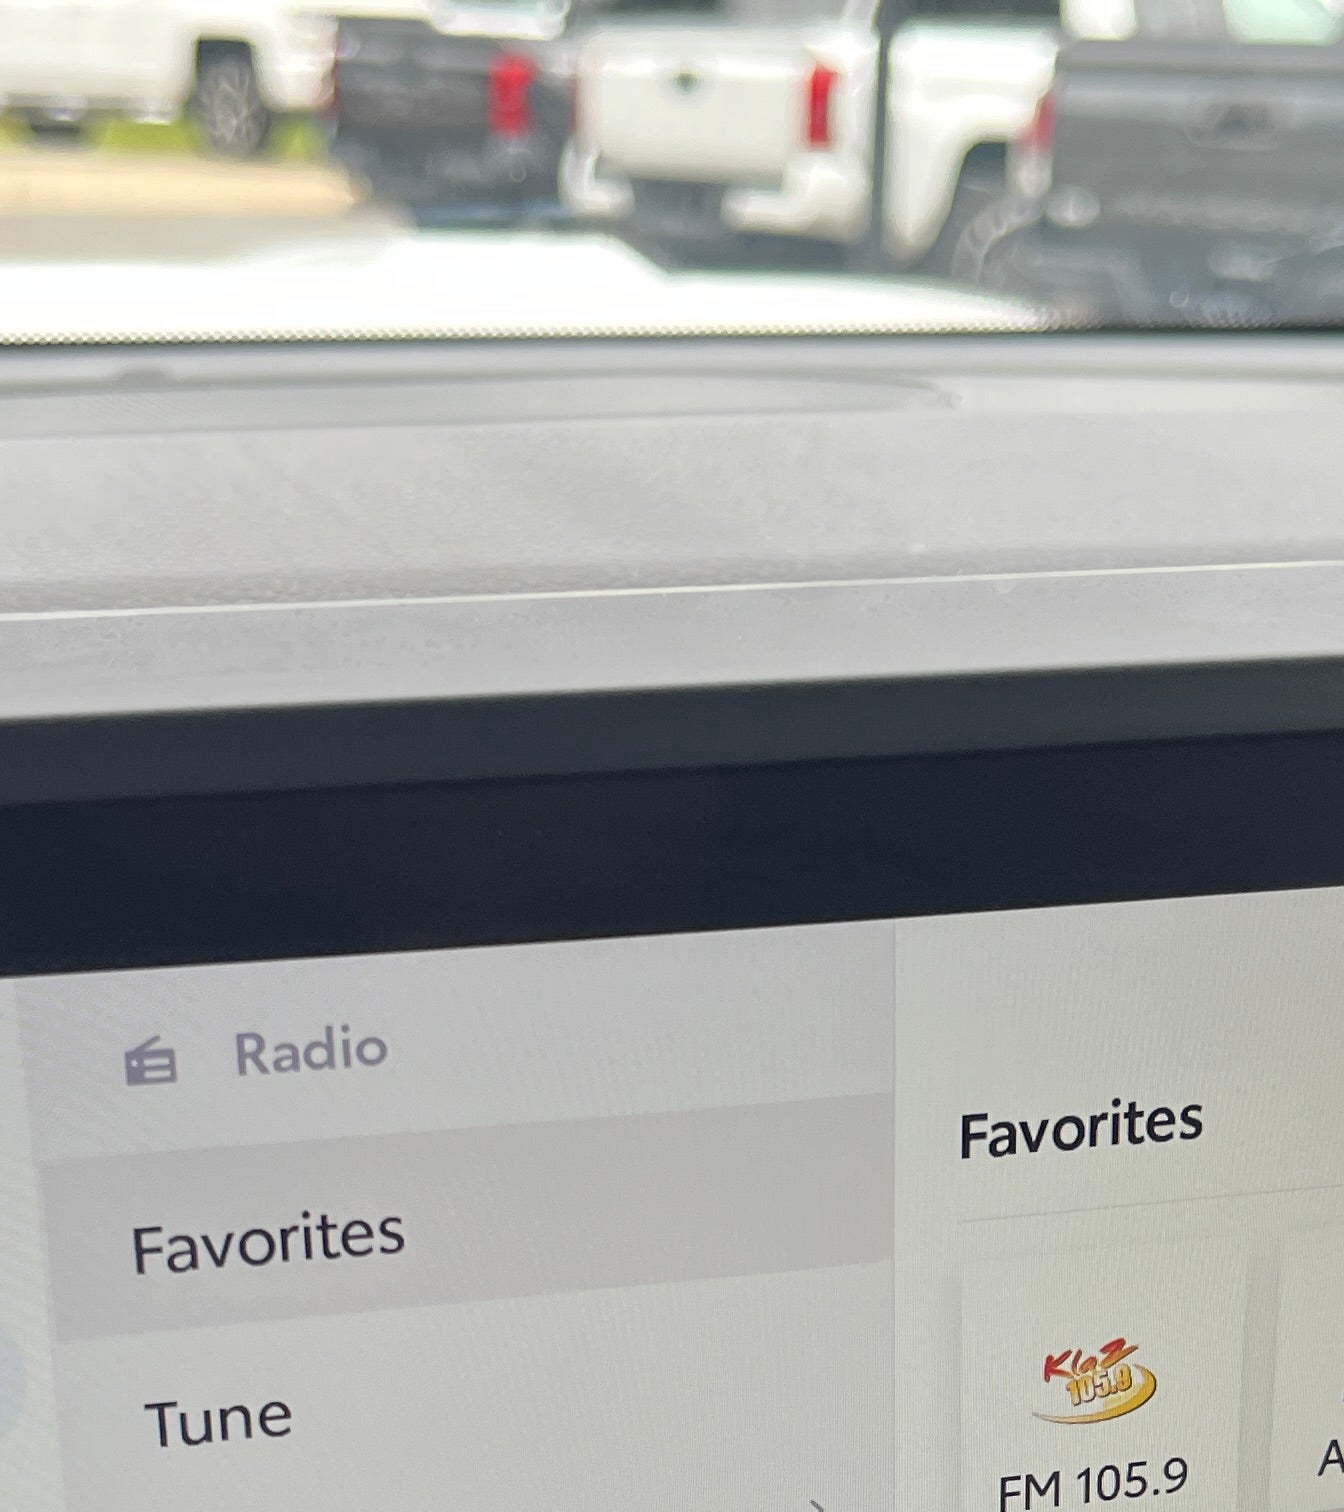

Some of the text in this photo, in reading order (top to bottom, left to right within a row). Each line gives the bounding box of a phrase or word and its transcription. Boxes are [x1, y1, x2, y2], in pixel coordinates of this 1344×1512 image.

[236, 1024, 387, 1077] Radio
[960, 1098, 1203, 1160] Favorites
[133, 1211, 405, 1275] Favorites
[143, 1400, 293, 1448] Tune
[1076, 1457, 1189, 1505] 105.9
